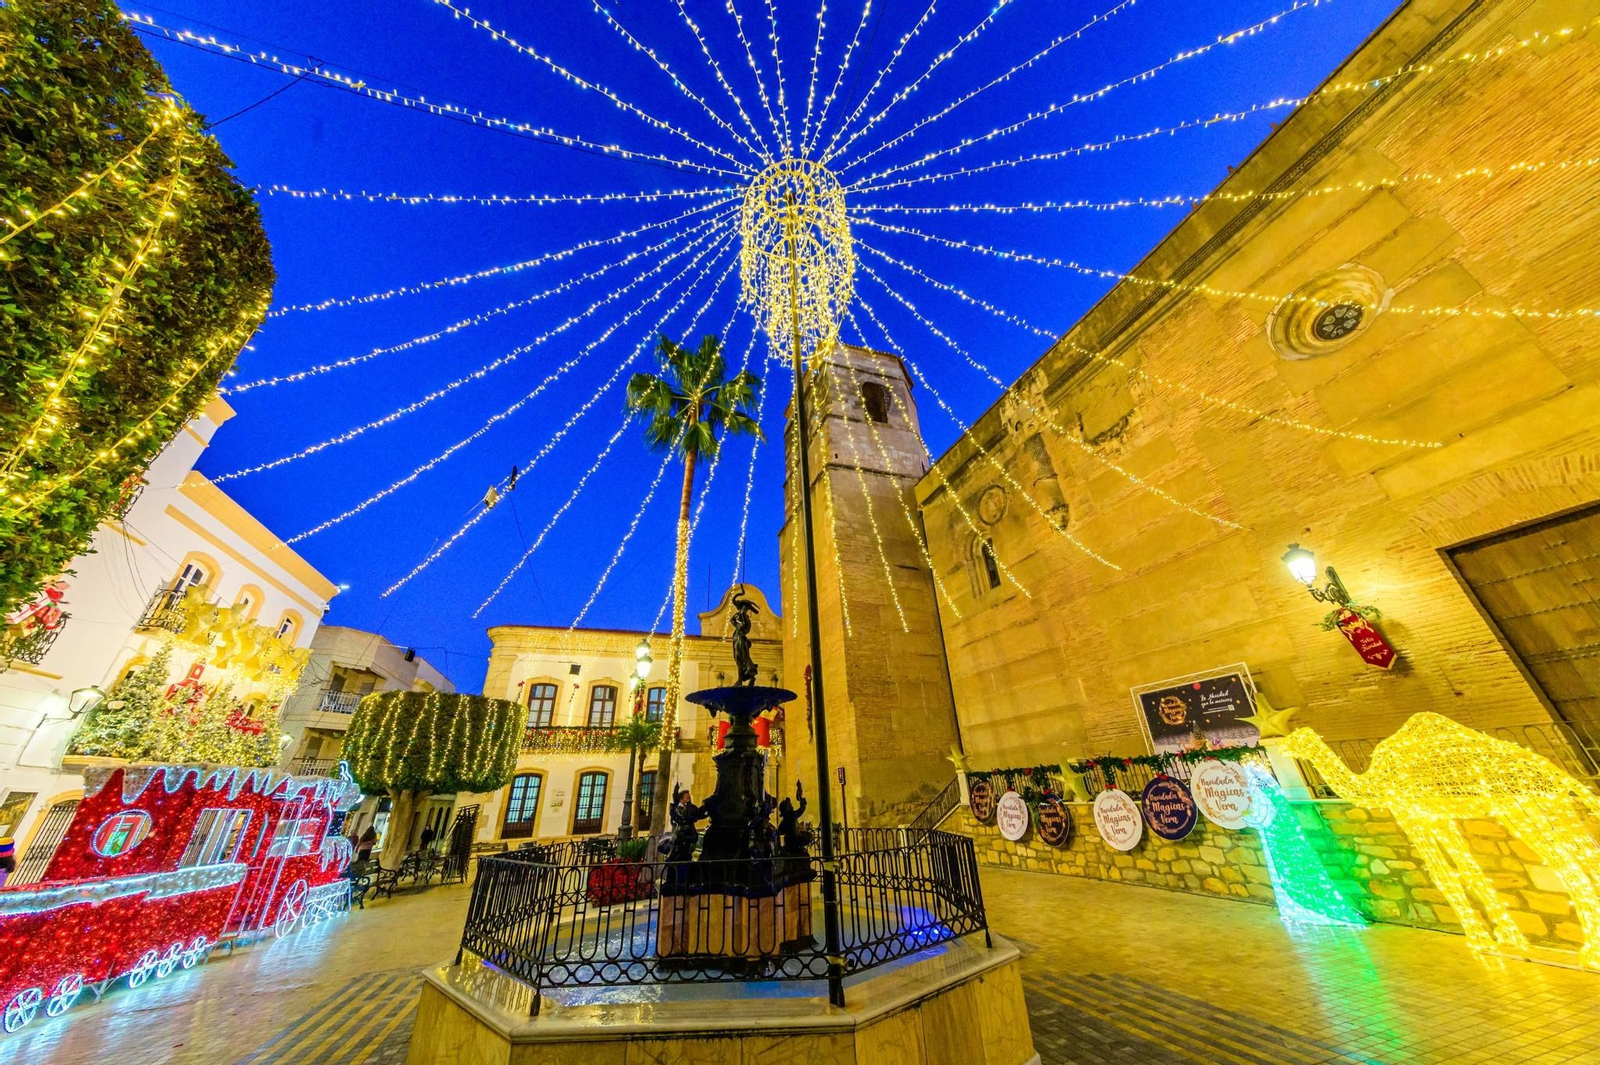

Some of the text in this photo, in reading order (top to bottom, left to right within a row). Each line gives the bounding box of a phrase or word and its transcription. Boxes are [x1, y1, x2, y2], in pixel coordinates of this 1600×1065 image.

[1215, 799, 1238, 812] Vera
[1160, 813, 1179, 825] Vera
[1110, 824, 1127, 836] Vera
